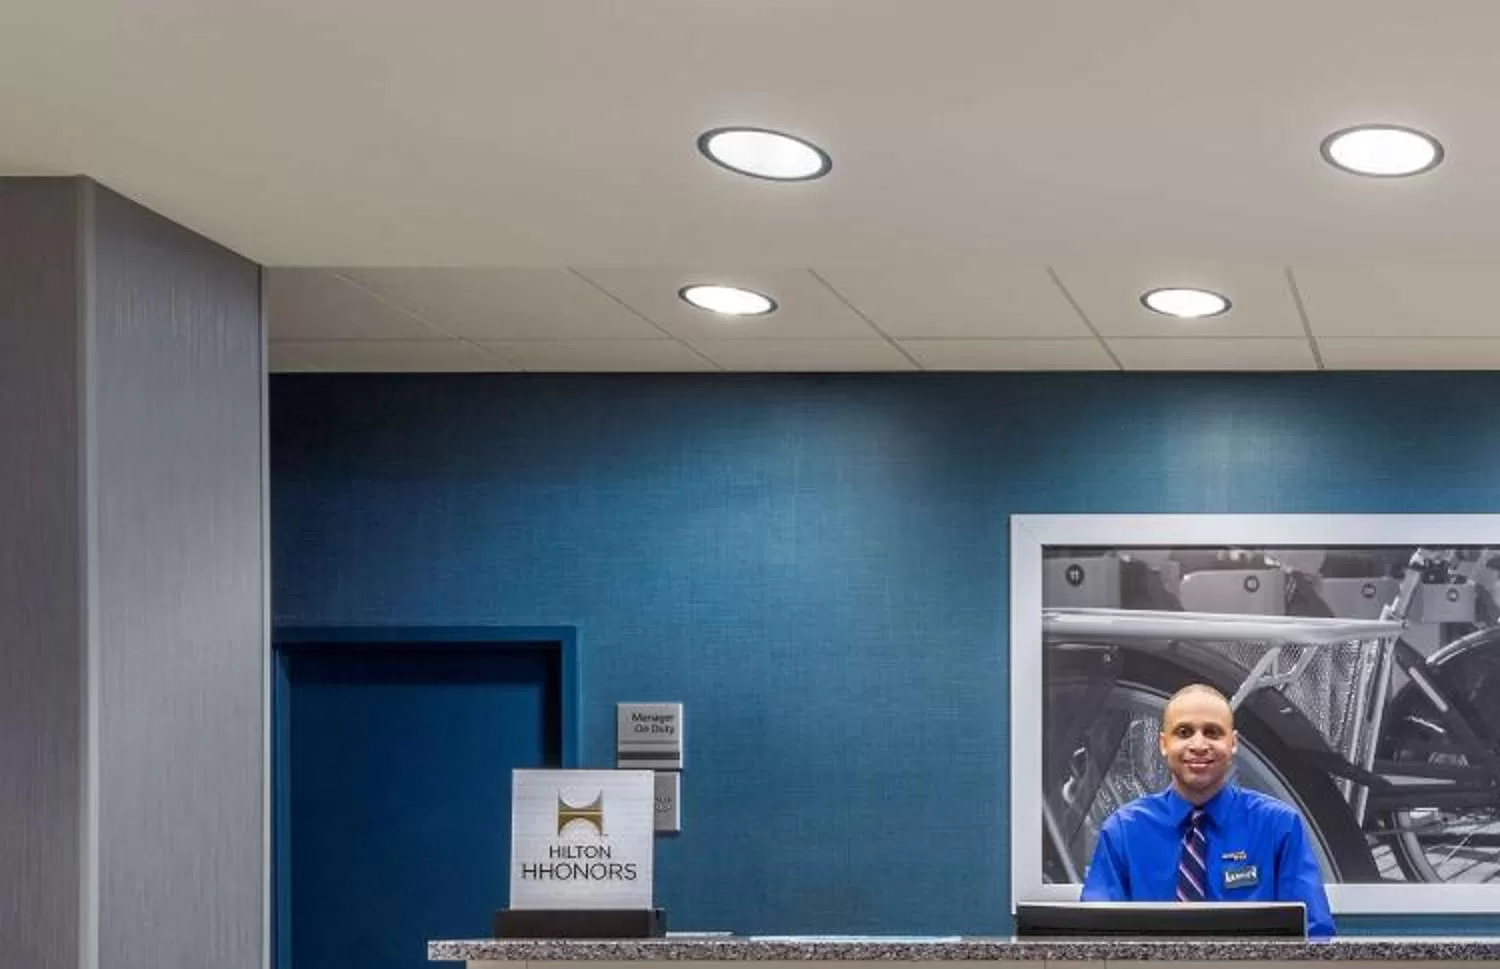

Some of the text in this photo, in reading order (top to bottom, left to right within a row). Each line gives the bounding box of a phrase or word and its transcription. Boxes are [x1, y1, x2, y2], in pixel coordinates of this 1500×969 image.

[631, 712, 675, 725] Manager
[634, 723, 675, 735] On Duty
[549, 845, 612, 860] HILTON
[521, 862, 638, 881] HHONORS
